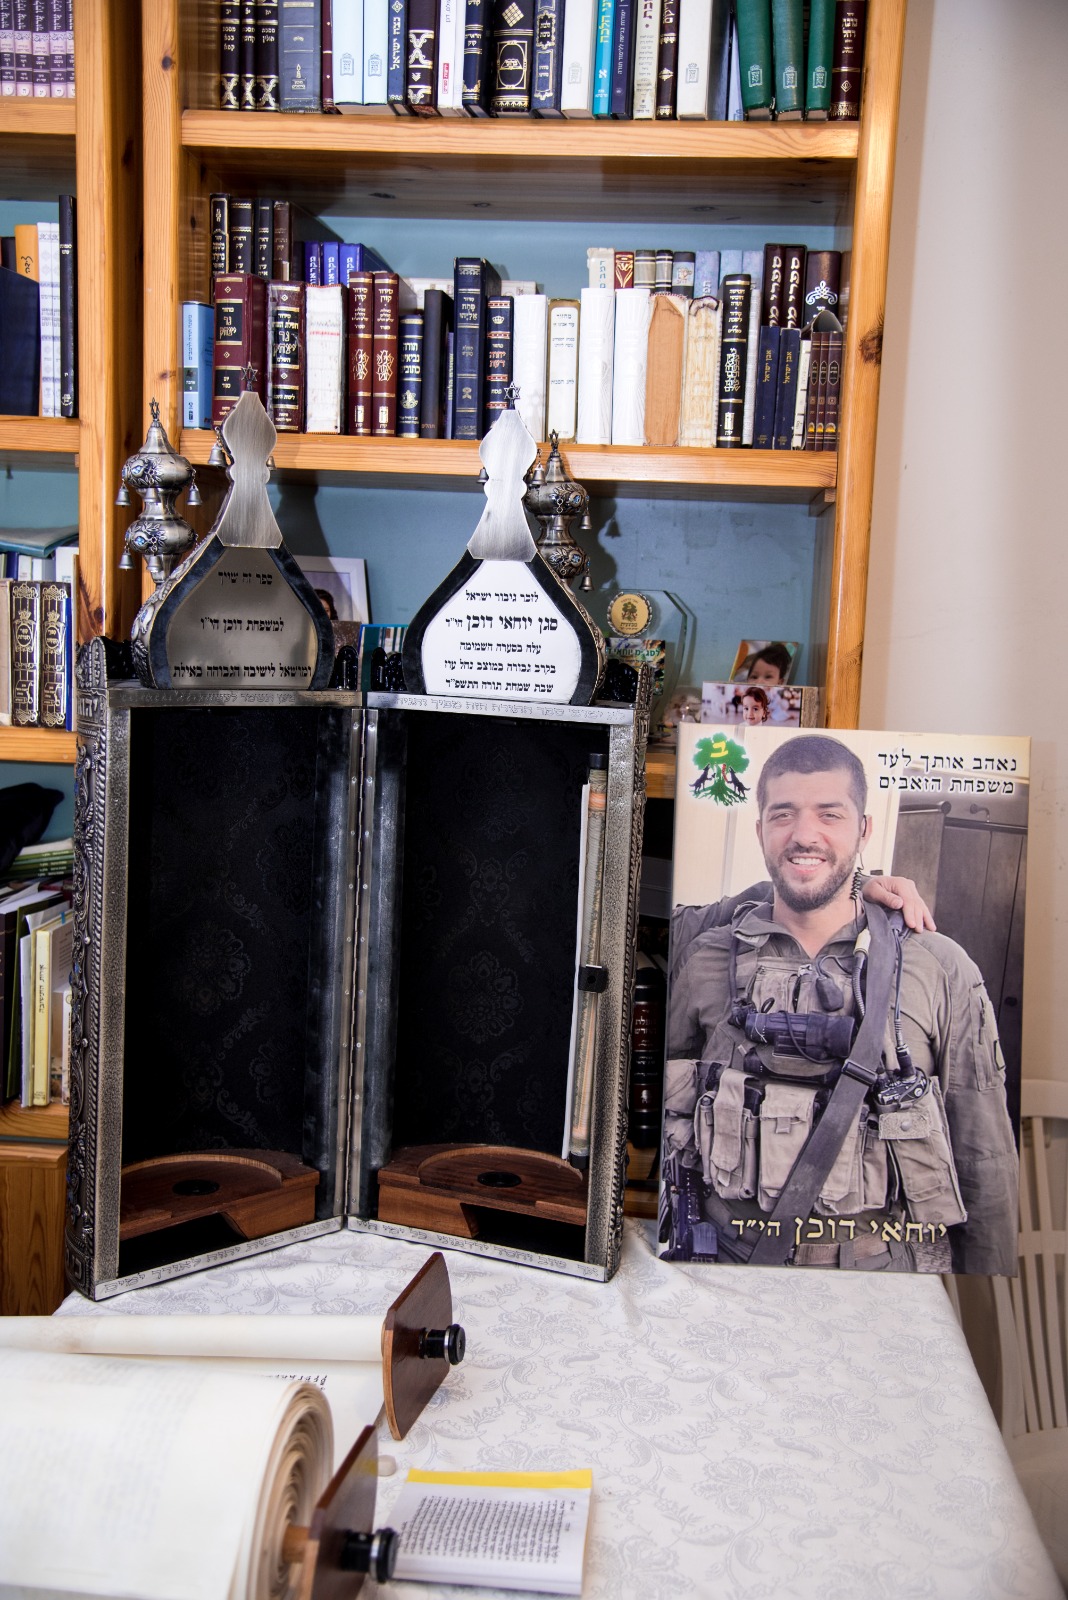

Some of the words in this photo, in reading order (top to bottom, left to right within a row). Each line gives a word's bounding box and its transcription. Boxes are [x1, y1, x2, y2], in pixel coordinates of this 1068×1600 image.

[390, 39, 401, 70] ישראל
[770, 256, 782, 301] ספרי
[788, 257, 800, 302] ספרי
[218, 572, 238, 585] שייך
[243, 572, 251, 583] זה
[256, 572, 272, 584] ספר
[466, 590, 492, 602] ישראל
[494, 593, 517, 602] גיבור
[520, 591, 539, 603] לזכר
[223, 619, 242, 633] דוכן
[246, 617, 284, 632] למשפחת
[466, 615, 493, 632] דוכן
[499, 616, 533, 629] יוחאי
[538, 617, 558, 634] סגן
[460, 642, 493, 651] השמימה
[496, 643, 522, 654] בסערה
[523, 643, 541, 654] עלה
[173, 663, 202, 678] באילת
[207, 665, 240, 678] הגבוהה
[244, 663, 275, 678] לישיבה
[444, 660, 457, 671] עוז
[460, 659, 473, 671] נחל
[477, 662, 503, 672] במוצב
[506, 663, 531, 673] גבורה
[535, 664, 556, 676] בקרב
[481, 681, 501, 691] תורה
[505, 682, 530, 692] שמחת
[534, 683, 553, 692] שבת
[878, 749, 912, 769] לעד
[920, 753, 964, 773] אותך
[973, 756, 1017, 772] נאהב
[879, 774, 941, 792] הזאבים
[950, 777, 1015, 794] משפחת
[795, 1217, 856, 1245] דוכן
[870, 1220, 947, 1243] יוחאי
